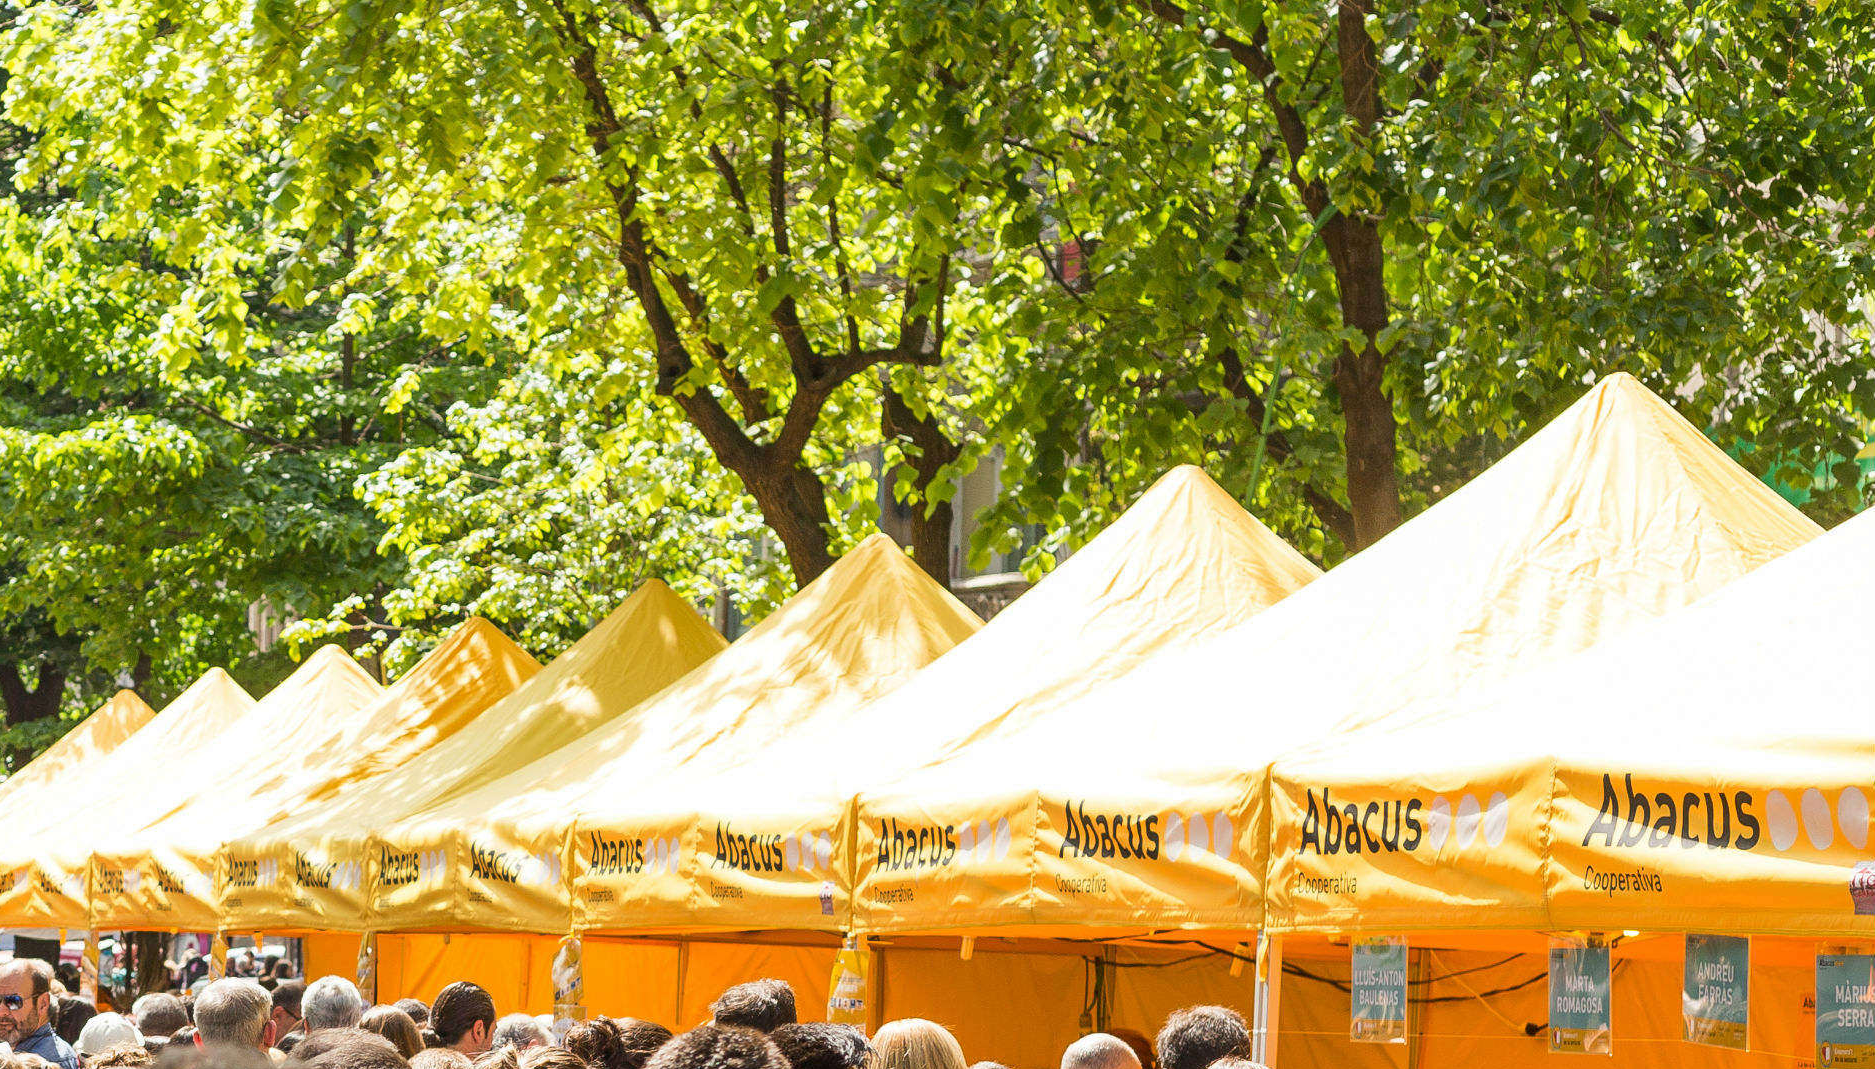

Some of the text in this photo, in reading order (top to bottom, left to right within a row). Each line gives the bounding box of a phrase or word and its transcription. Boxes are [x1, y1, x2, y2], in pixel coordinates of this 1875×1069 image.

[1299, 787, 1423, 855] Abacus
[1582, 773, 1760, 851] Abacus
[711, 821, 784, 873] Abacus
[875, 817, 956, 872] Abacus
[1058, 799, 1160, 861] Abacus
[295, 850, 337, 888] Abacus
[379, 846, 420, 887] Abacus
[470, 840, 529, 884] Abacus
[587, 831, 644, 874] Abacus
[710, 881, 744, 900] Cooperativa
[874, 885, 914, 904] Cooperativa
[1055, 873, 1108, 896] Cooperativa
[1298, 872, 1358, 897] Cooperativa
[1584, 865, 1662, 897] Cooperativa
[1565, 975, 1595, 992] MARTA
[1697, 961, 1734, 983] ANDREU
[1359, 989, 1399, 1006] BAULENAS
[1556, 996, 1604, 1014] ROMAGOSA
